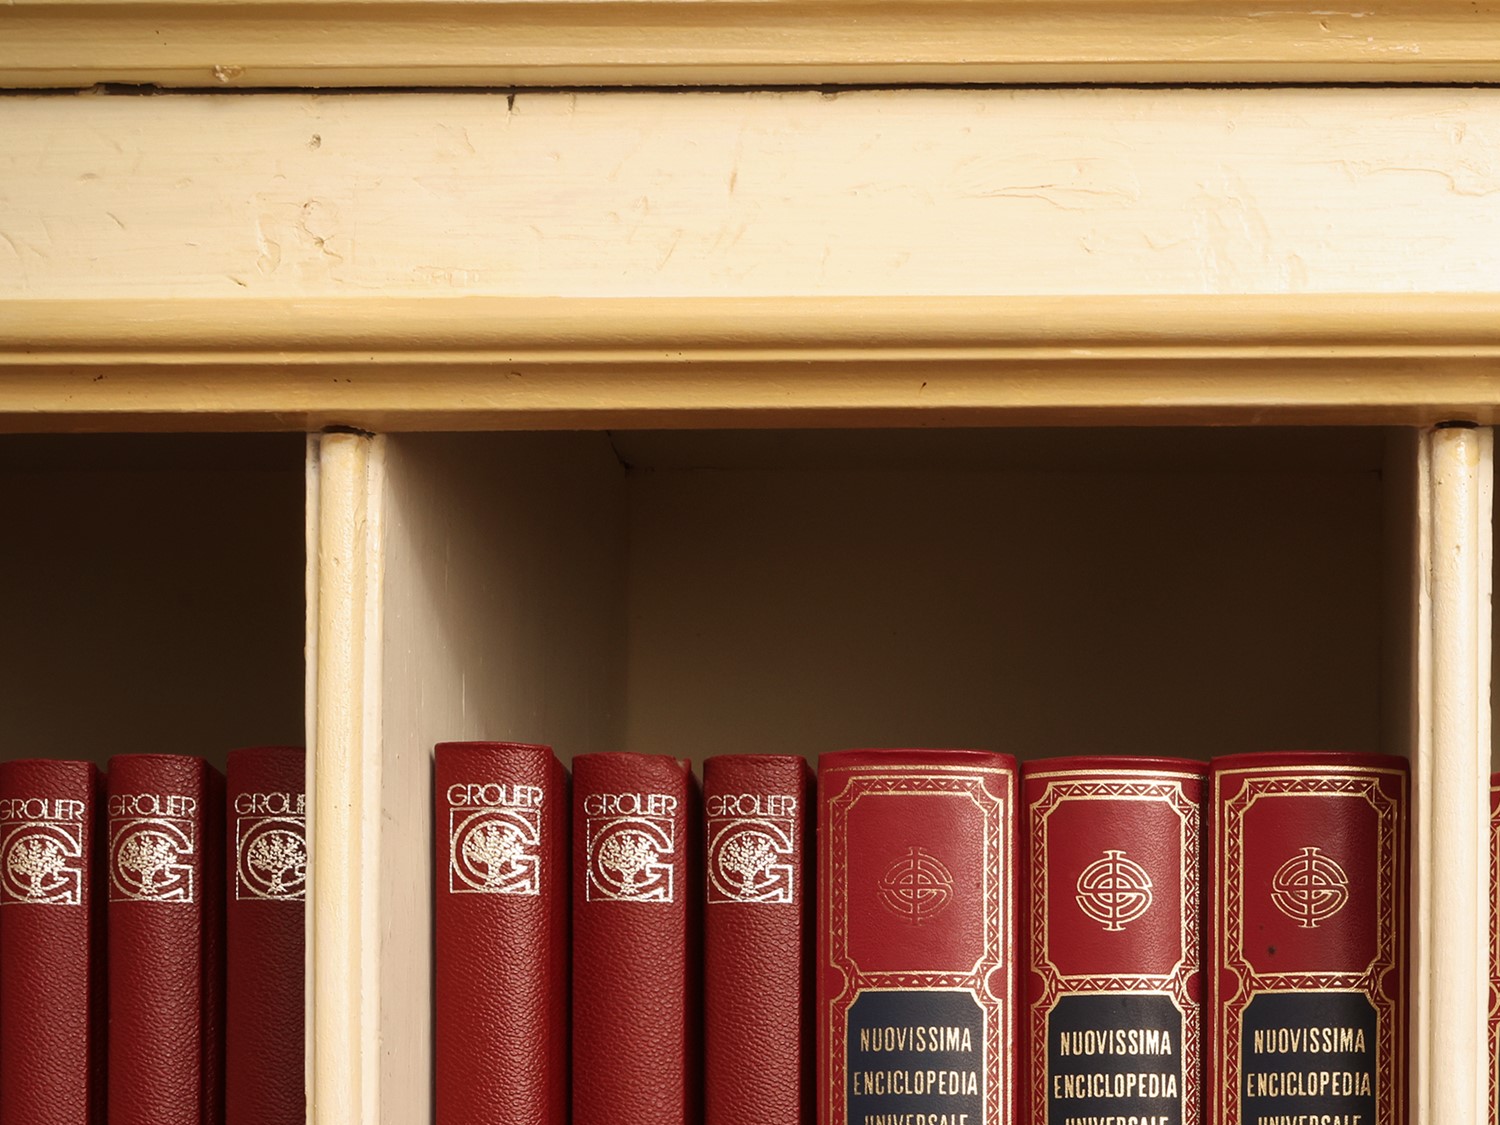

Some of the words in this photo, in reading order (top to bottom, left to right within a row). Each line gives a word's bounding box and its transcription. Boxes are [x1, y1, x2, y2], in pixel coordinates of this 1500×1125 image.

[235, 792, 306, 815] GROLI
[861, 1027, 972, 1052] NUOVISSIMA
[1061, 1030, 1171, 1055] NUOVISSIMA
[1255, 1028, 1364, 1053] NUOVISSIMA
[854, 1071, 978, 1095] ENCICLOPEDIA
[1055, 1074, 1177, 1098] ENCICLOPEDIA
[1248, 1072, 1370, 1096] ENCICLOPEDIA
